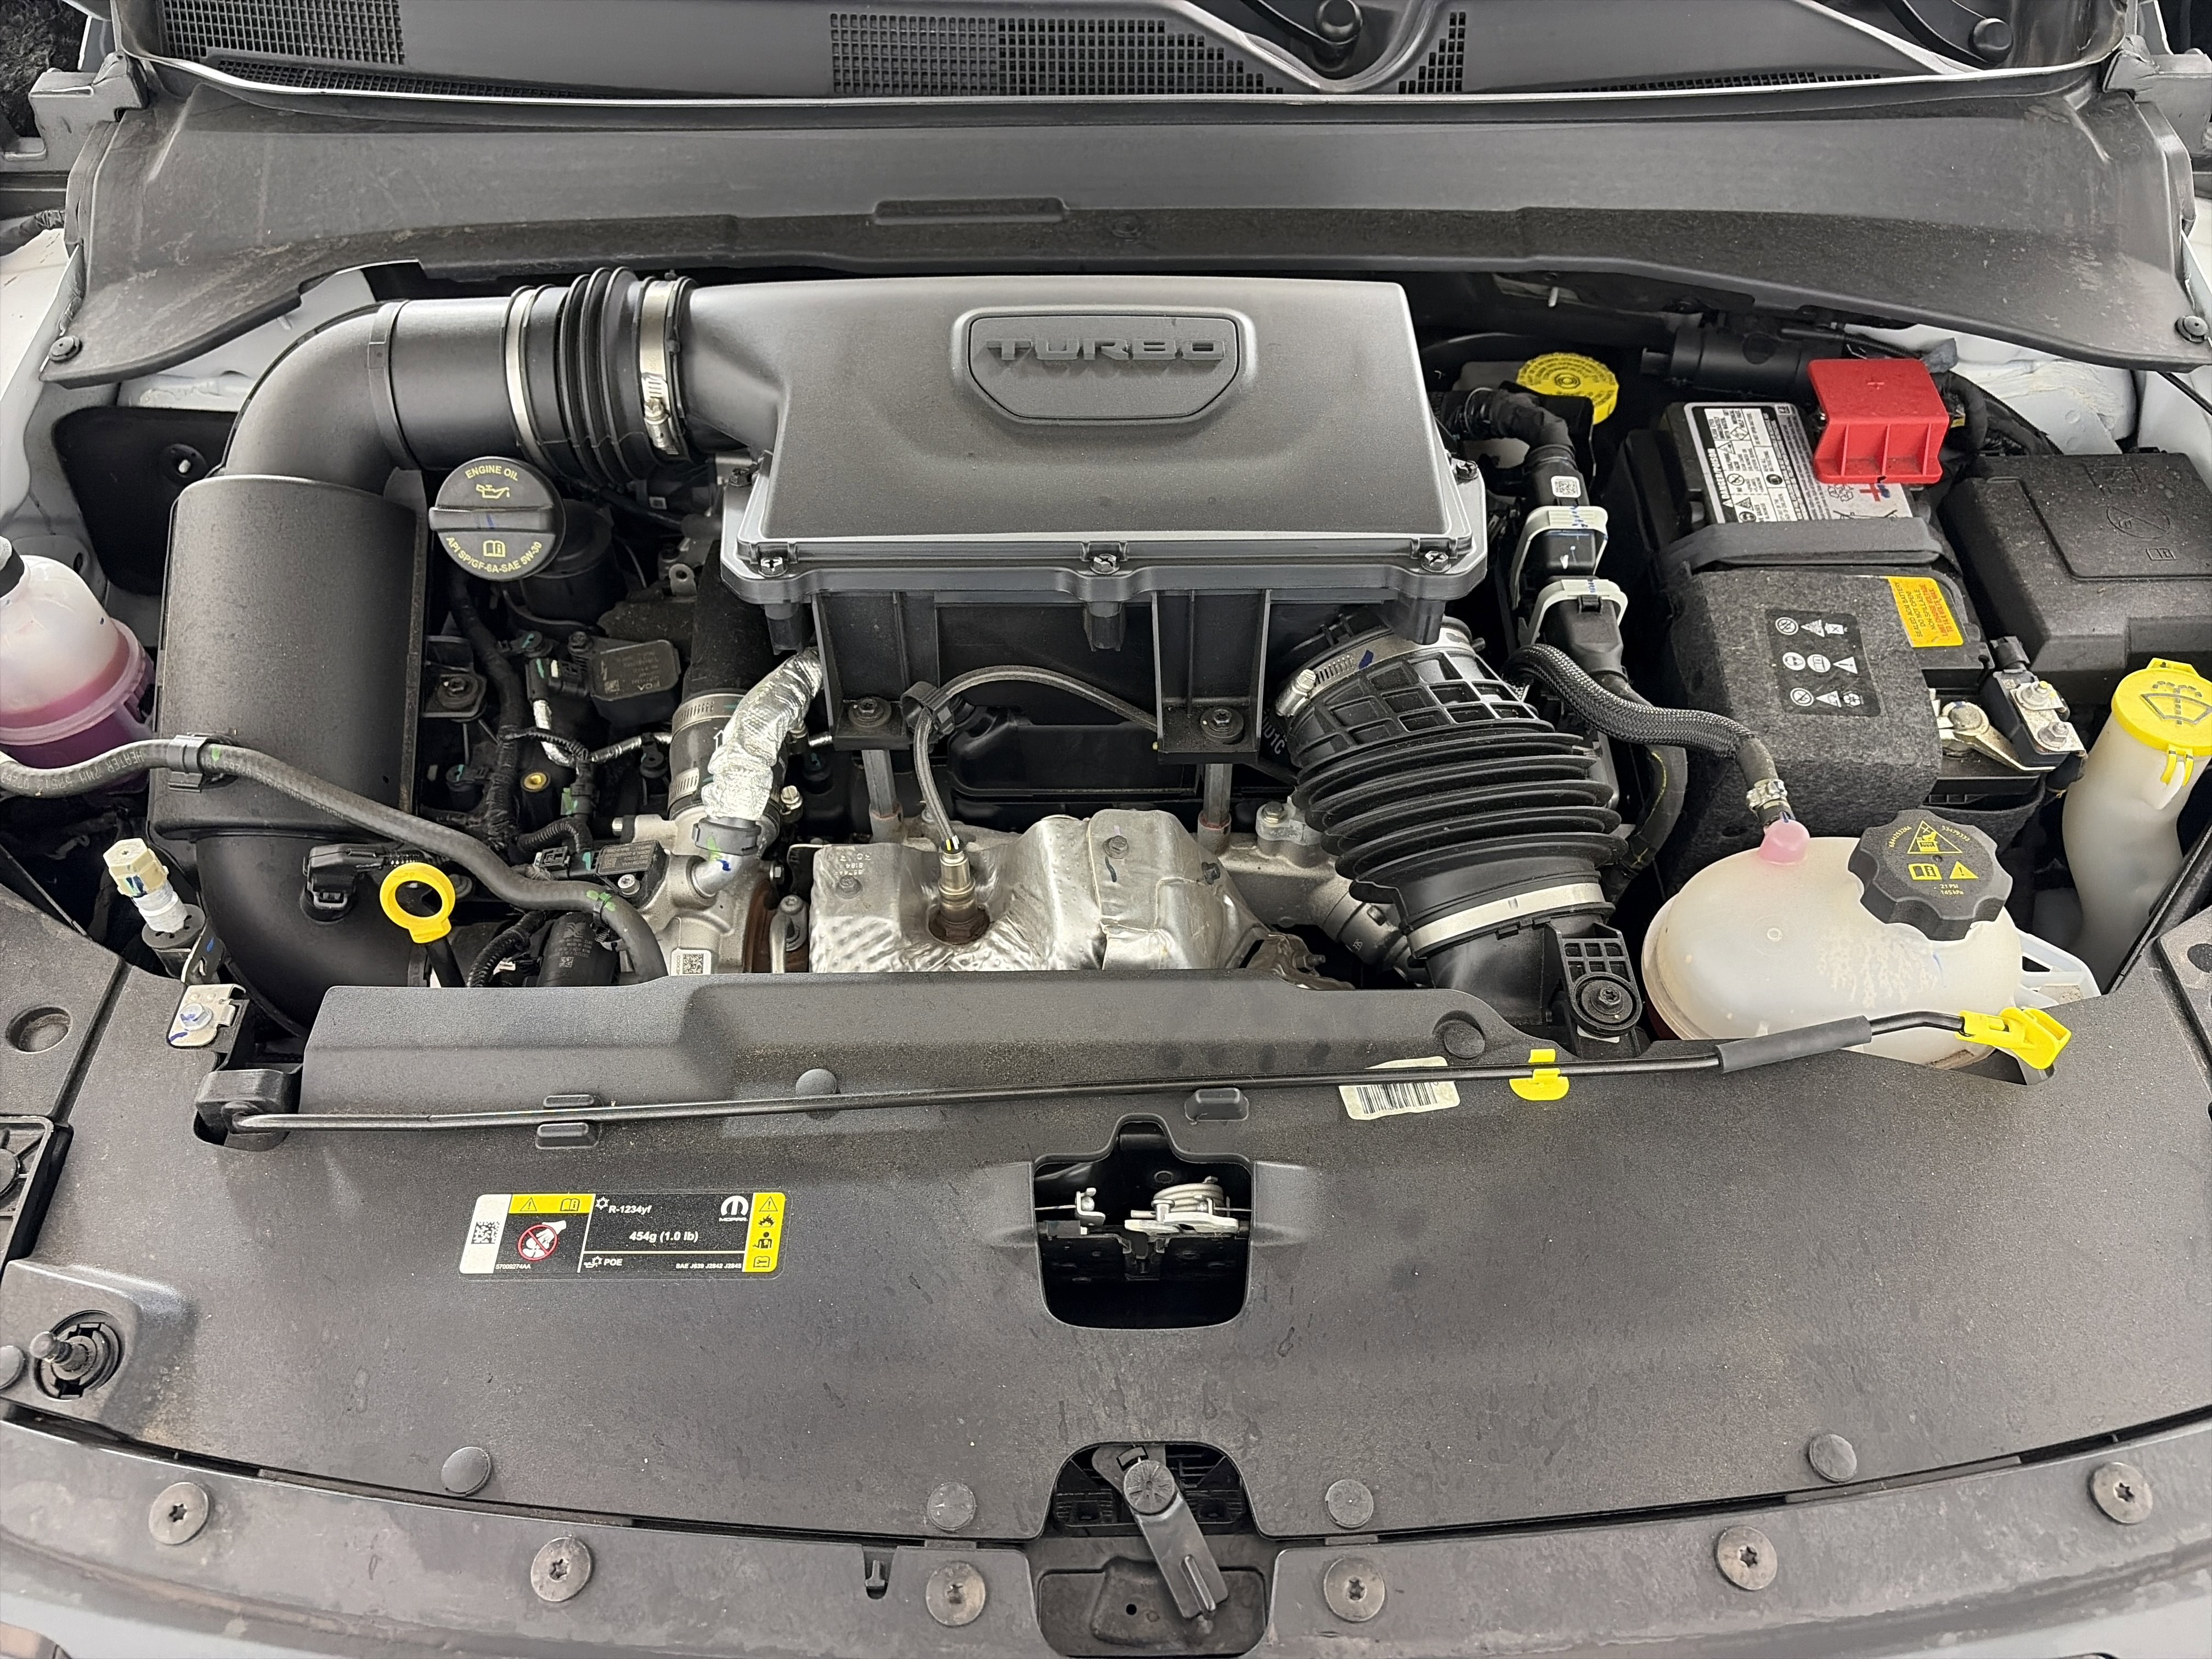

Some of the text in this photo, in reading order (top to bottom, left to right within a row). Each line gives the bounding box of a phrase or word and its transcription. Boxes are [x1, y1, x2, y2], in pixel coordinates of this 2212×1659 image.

[986, 338, 1226, 361] TURBO
[465, 465, 519, 481] ENGINE OIL
[445, 535, 461, 553] API
[521, 541, 543, 566] 5W-30
[105, 750, 144, 773] HEATER
[608, 1205, 652, 1215] R-1234yf
[629, 1231, 699, 1244] 454g (1.0 lb)
[603, 1258, 623, 1266] POE
